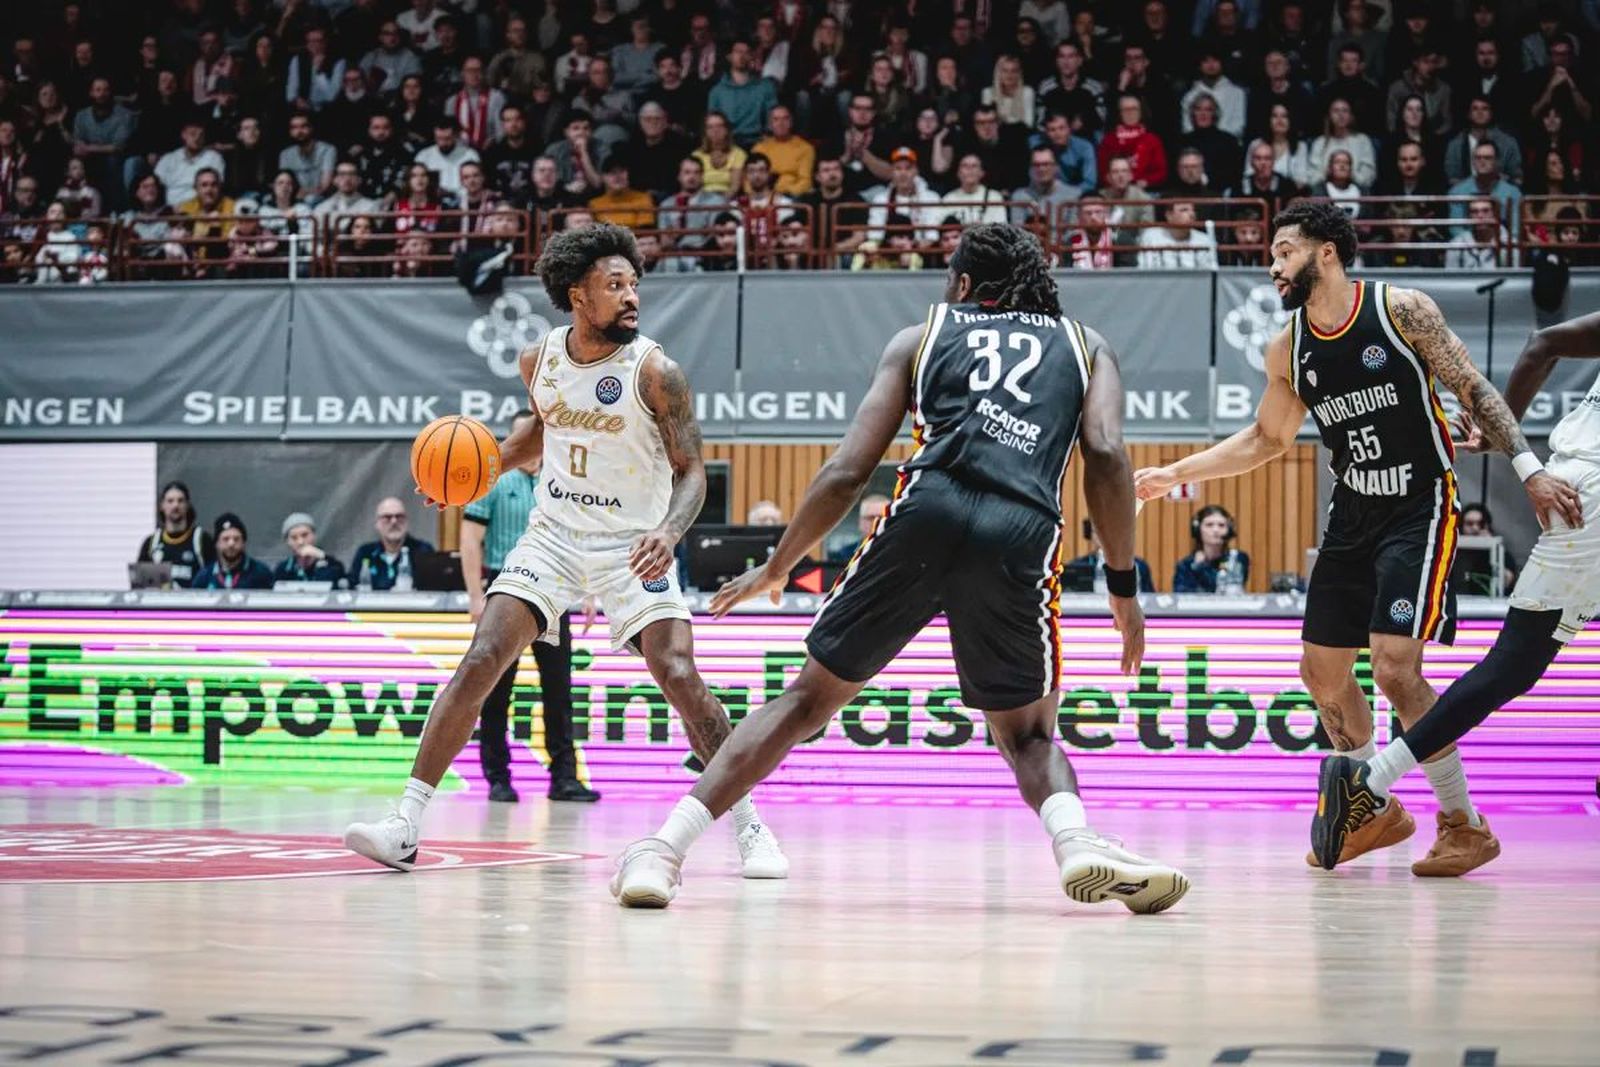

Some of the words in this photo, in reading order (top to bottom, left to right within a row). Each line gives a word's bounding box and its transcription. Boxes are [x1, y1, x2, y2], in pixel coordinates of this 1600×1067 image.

[967, 329, 1042, 404] 32
[5, 397, 124, 425] NGEN
[183, 390, 440, 424] SPIELBANK
[541, 400, 625, 432] Levice
[1314, 382, 1399, 427] WÜRZBURG
[982, 419, 1037, 455] LEASING
[1347, 425, 1382, 463] 55
[569, 444, 588, 478] 0
